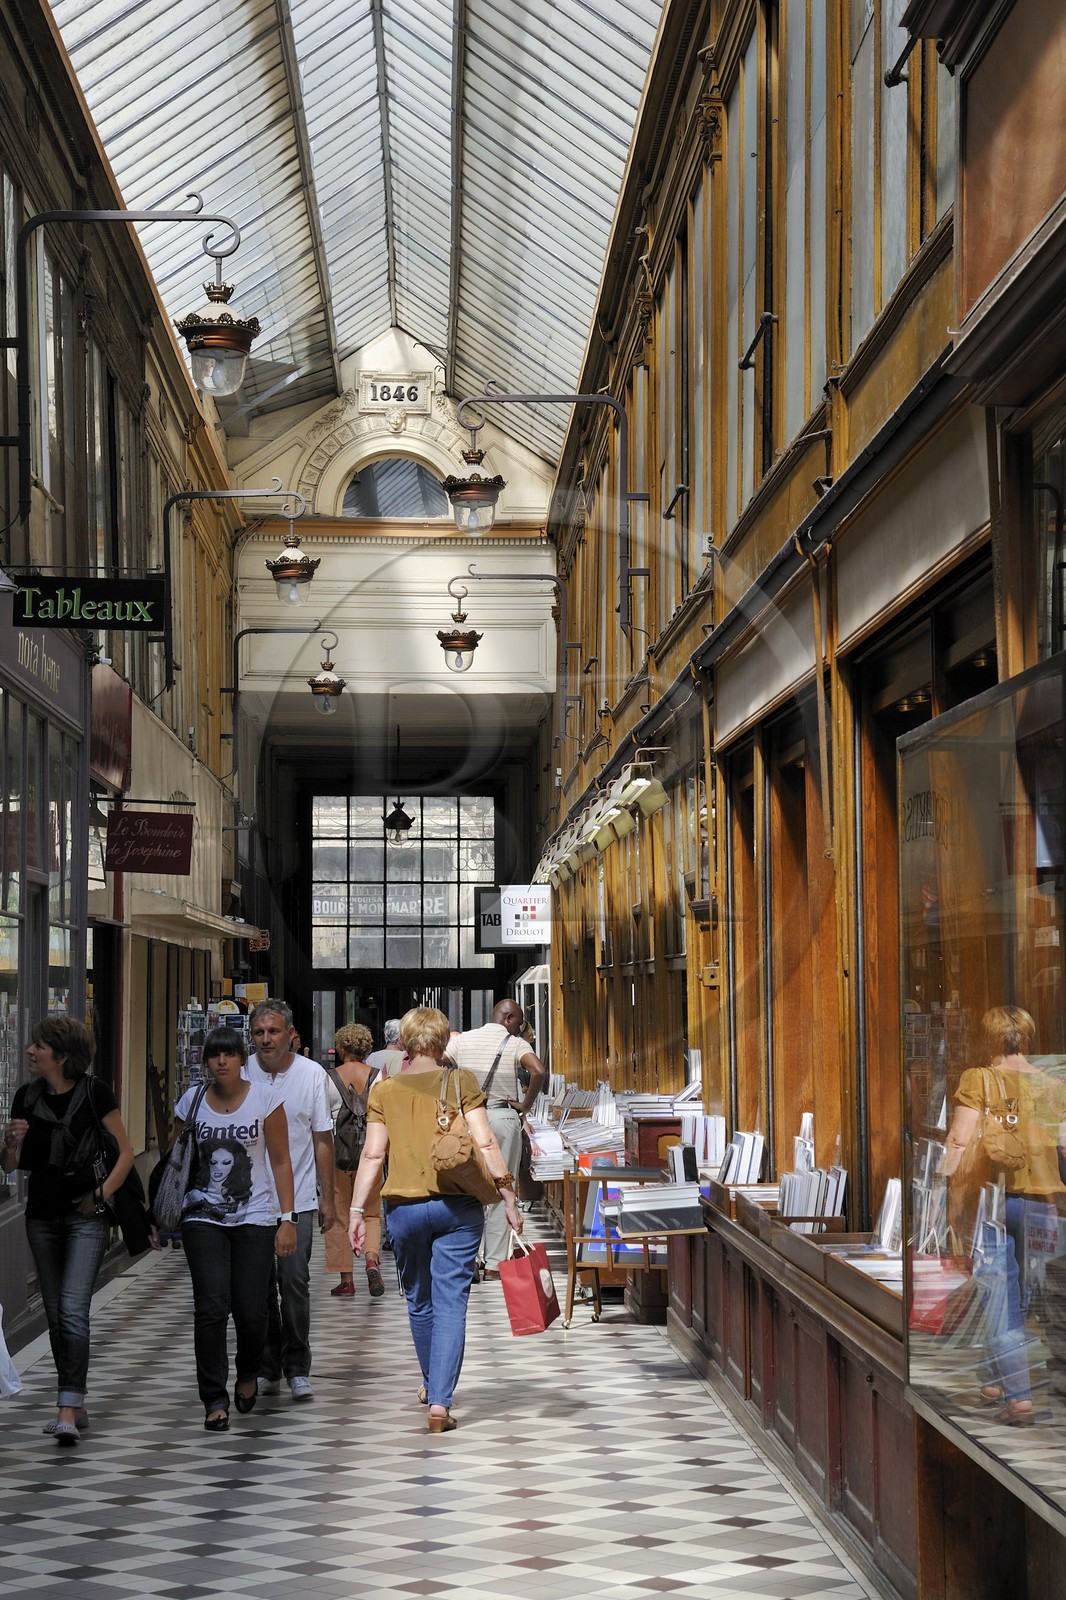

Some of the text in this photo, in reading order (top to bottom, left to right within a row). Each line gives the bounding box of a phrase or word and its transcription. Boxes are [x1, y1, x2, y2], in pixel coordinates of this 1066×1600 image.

[370, 383, 419, 402] 1846
[16, 586, 155, 622] Tableaux
[18, 631, 60, 693] nota bene
[109, 817, 187, 839] Le Boudoir
[107, 840, 182, 866] de Joséphine
[358, 897, 445, 915] MONTMARTRE
[502, 896, 547, 906] QUARTIER
[481, 913, 501, 927] TAB
[506, 928, 544, 936] DROUOT
